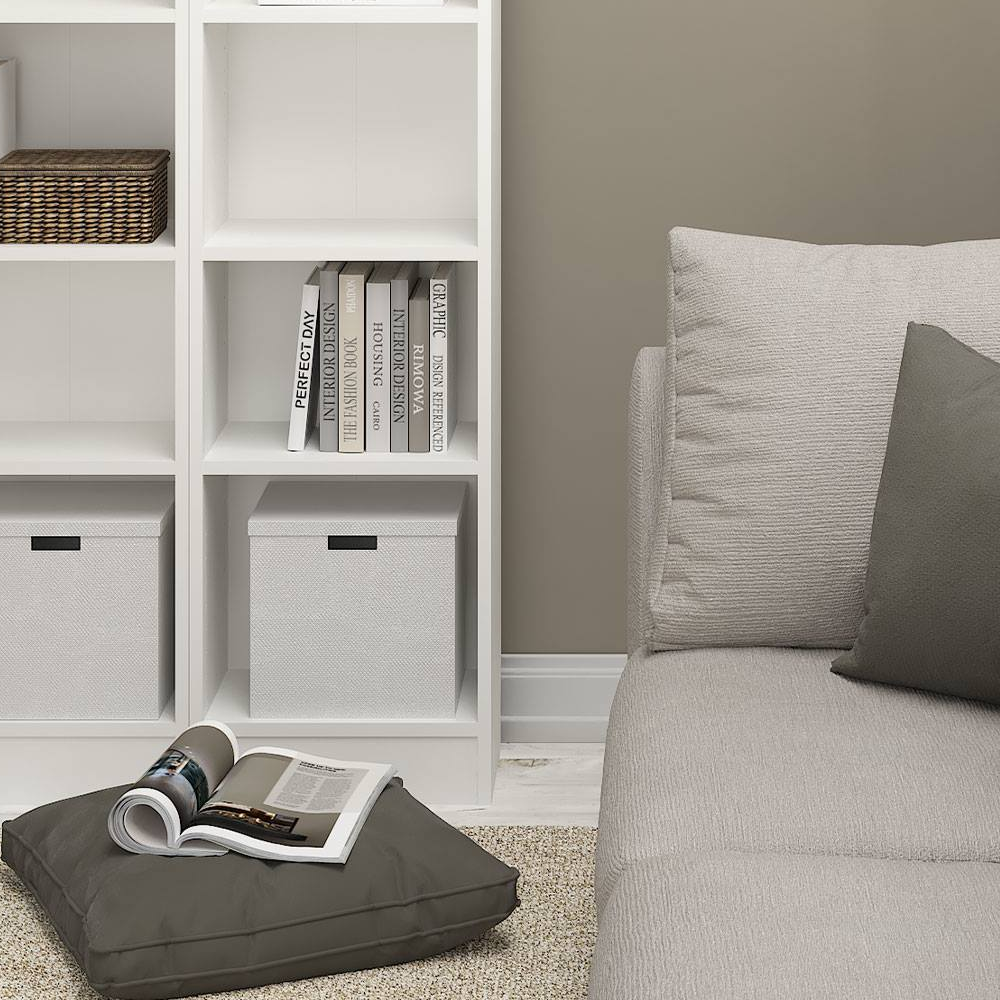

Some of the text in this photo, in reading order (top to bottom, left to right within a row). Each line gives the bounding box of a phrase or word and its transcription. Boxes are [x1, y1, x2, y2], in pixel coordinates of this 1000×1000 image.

[294, 310, 316, 409] PERFECT DAY
[322, 302, 336, 422] INTERIOR DESIGN
[343, 336, 358, 443] THE FASHION BOOK
[372, 322, 383, 432] HOUSING CAIRO
[393, 308, 406, 424] INTERIOR DESIGN
[412, 344, 425, 415] RIMOWA
[432, 283, 447, 453] GRAPHIC DISIGN REFERENCED
